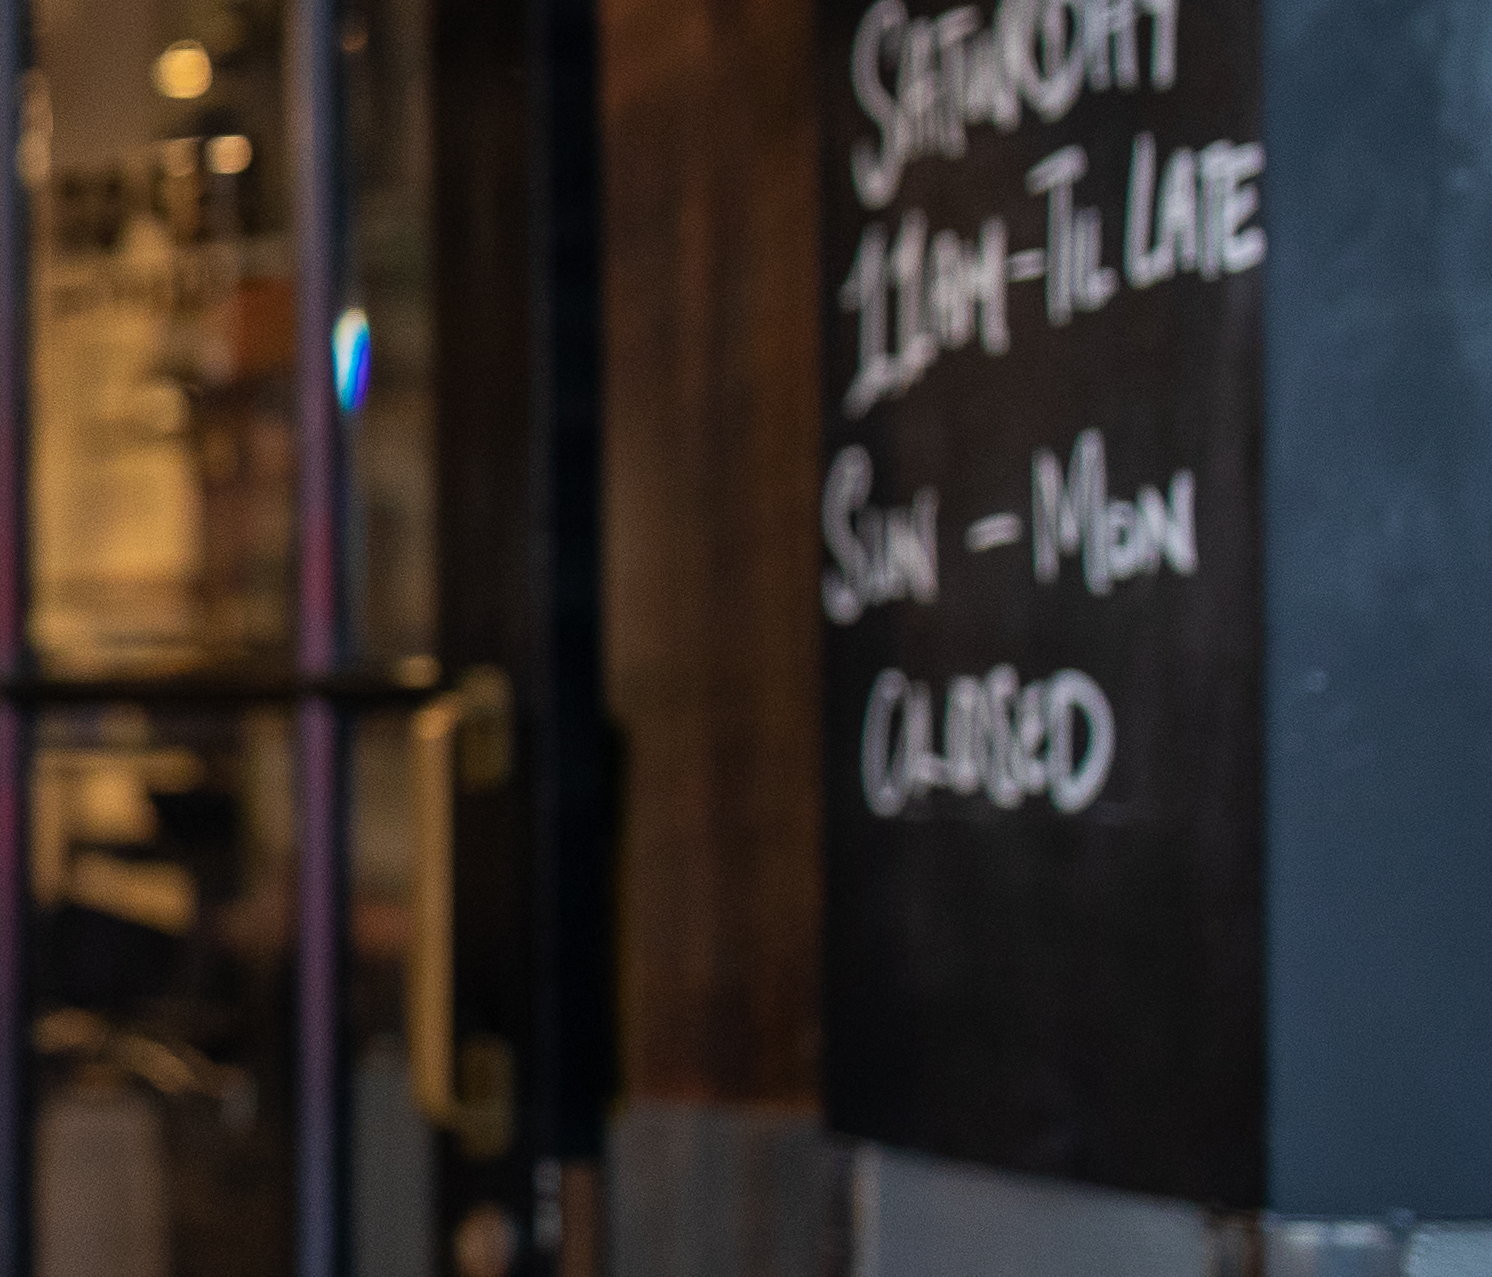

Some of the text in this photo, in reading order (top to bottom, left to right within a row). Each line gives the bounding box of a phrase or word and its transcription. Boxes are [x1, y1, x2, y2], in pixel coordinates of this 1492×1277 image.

[1128, 130, 1267, 288] LATE
[822, 443, 939, 626] SUN
[1032, 427, 1198, 596] MON
[861, 663, 1115, 817] CLOSED
